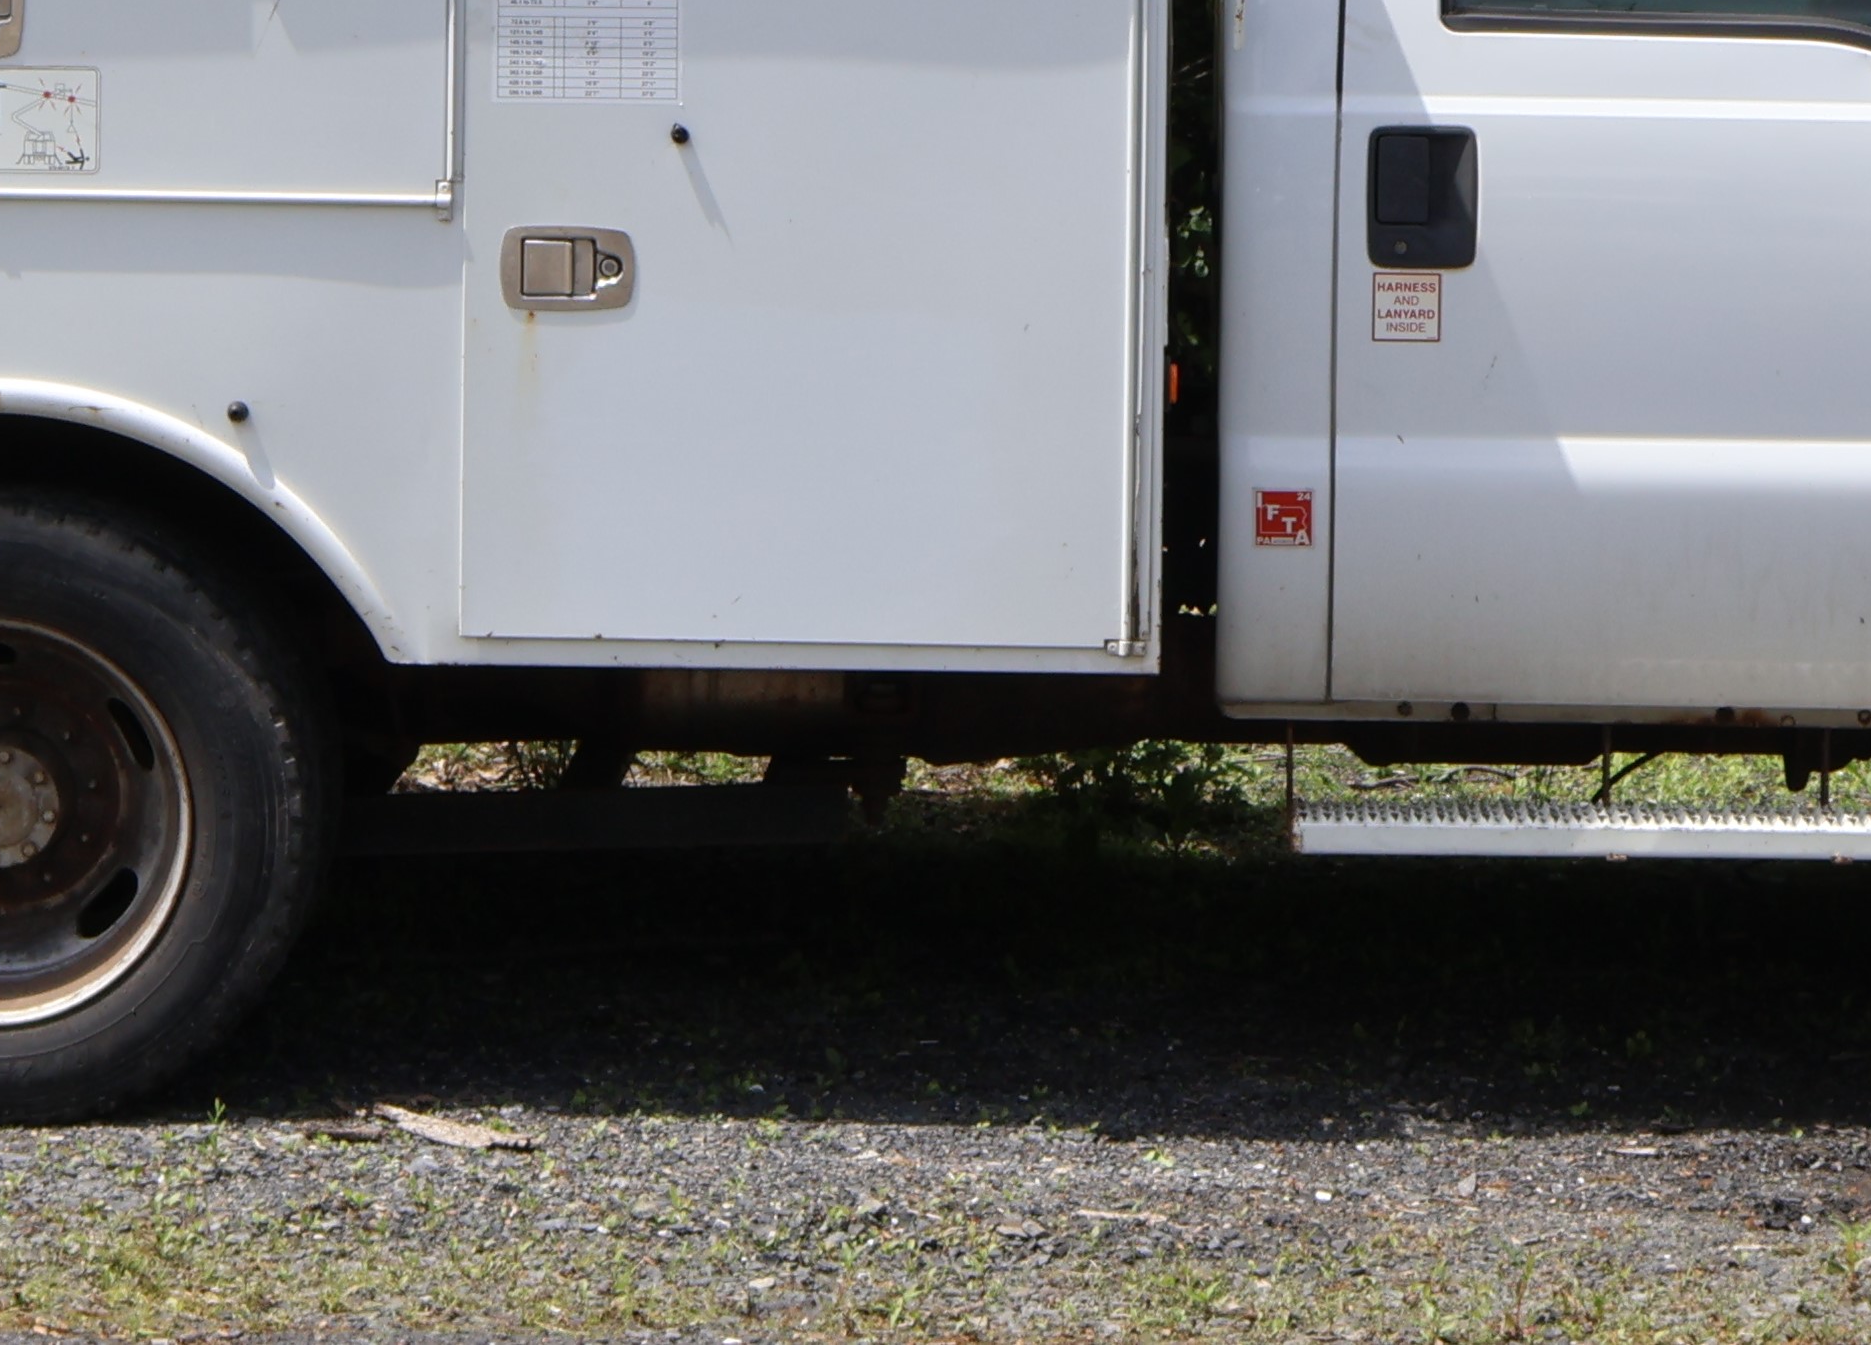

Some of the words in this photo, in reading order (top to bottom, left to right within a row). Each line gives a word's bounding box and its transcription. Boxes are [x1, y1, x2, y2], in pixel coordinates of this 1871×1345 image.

[1377, 282, 1437, 293] HARNESS
[1393, 295, 1420, 306] AND
[1377, 309, 1436, 320] LANYARD
[1386, 322, 1426, 333] INSIDE
[1296, 492, 1311, 501] 24
